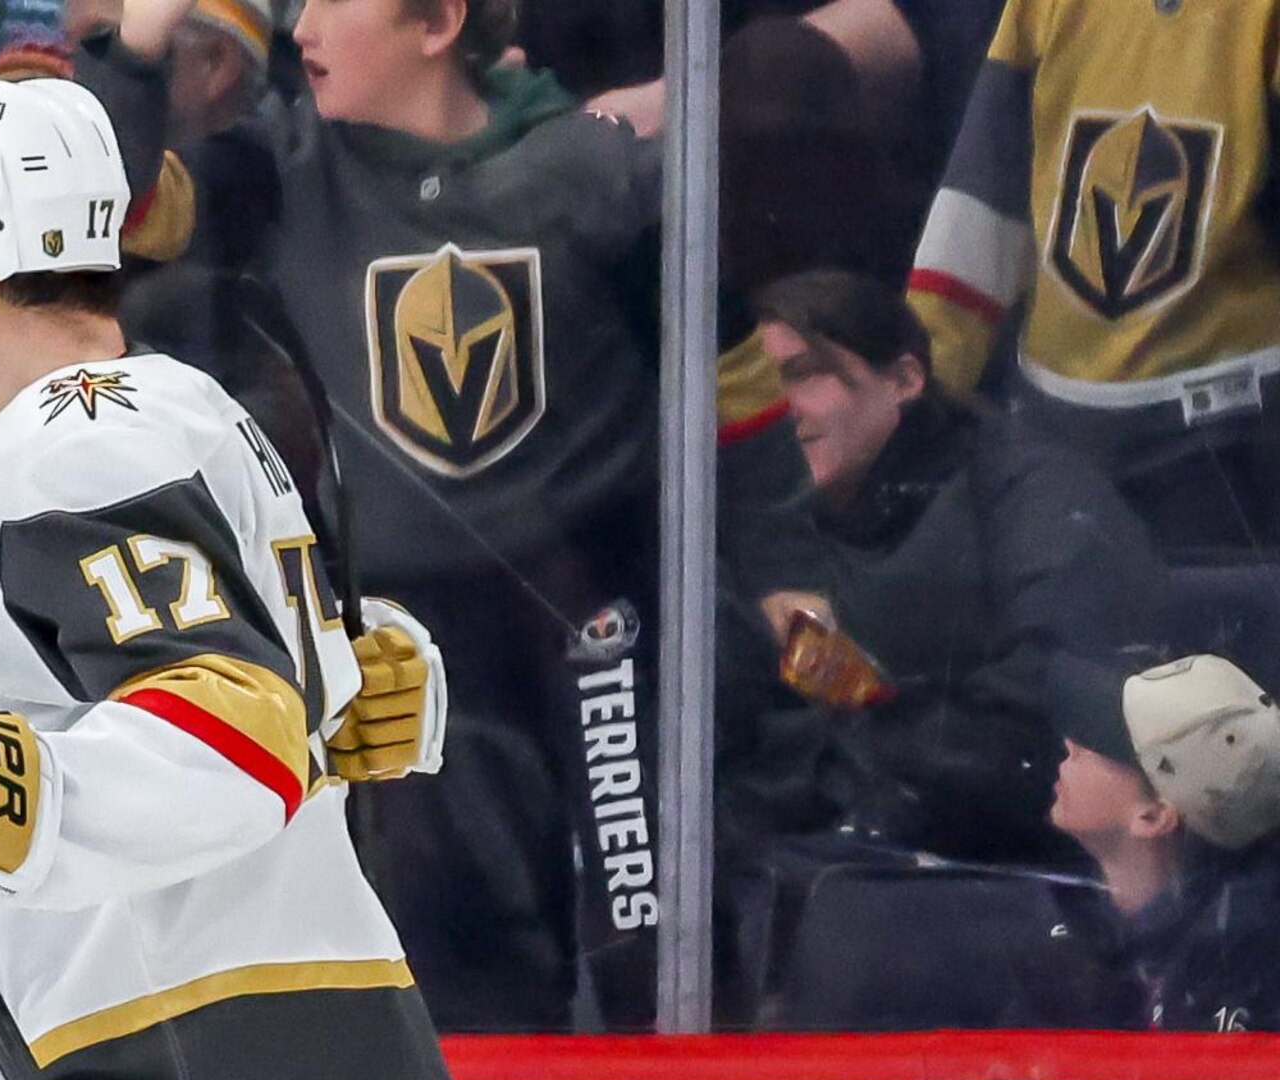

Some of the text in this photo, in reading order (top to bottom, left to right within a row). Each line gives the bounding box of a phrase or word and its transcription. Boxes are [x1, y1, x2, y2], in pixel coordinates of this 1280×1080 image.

[86, 199, 115, 239] 17
[79, 534, 231, 645] 17
[578, 658, 659, 931] TERRIERS
